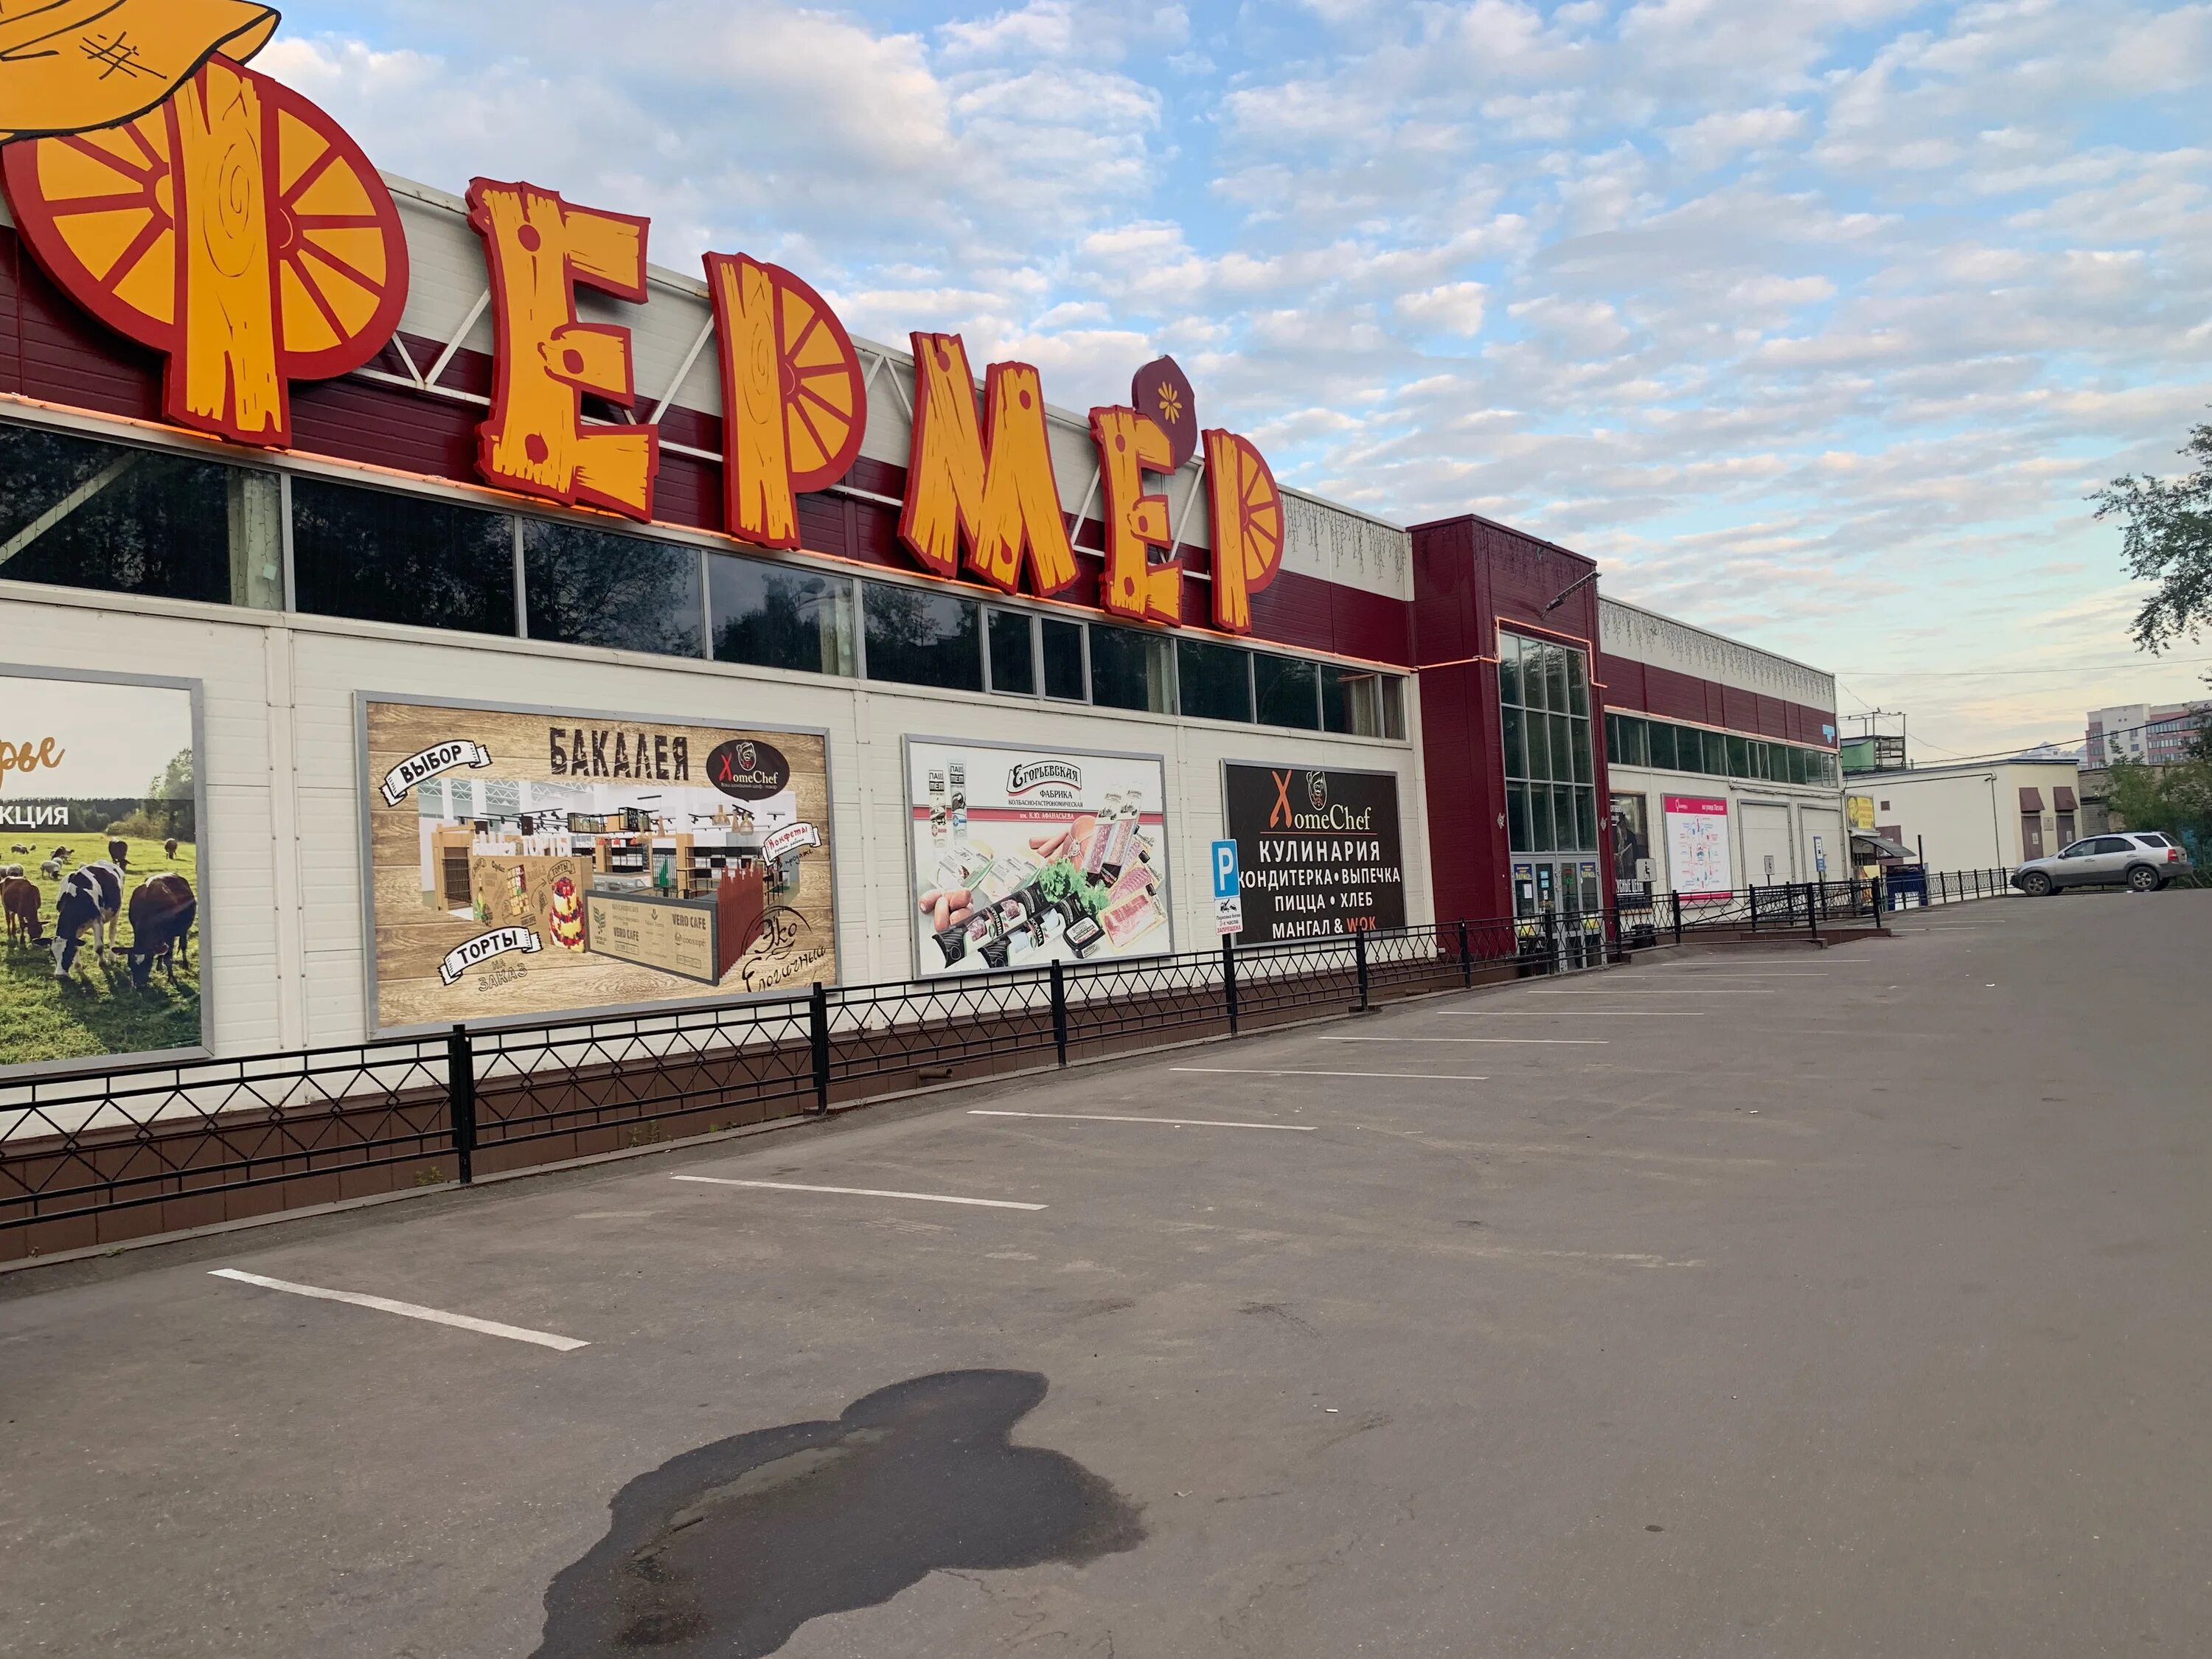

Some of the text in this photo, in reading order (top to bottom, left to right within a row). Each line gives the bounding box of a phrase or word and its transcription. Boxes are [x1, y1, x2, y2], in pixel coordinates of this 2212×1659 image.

[3, 55, 1284, 634] ФЕРМЕР
[400, 745, 462, 784] ВЫБОР
[549, 727, 689, 781] БАКАЛЕЯ
[1008, 799, 1083, 808] КОЛБАСНО-ГАСТРОНОМИЧЕСКАЯ
[1040, 790, 1073, 799] ФАБРИКА
[1259, 841, 1380, 863] КУЛИНАРИЯ
[1343, 867, 1401, 884] ВЫПЕЧКА
[1275, 892, 1373, 913] ПИЦЦА ХЛЕБ
[672, 914, 689, 927] VERO
[689, 917, 706, 931] CAFE
[1272, 919, 1330, 939] МАНГАЛ
[457, 930, 518, 964] ТОРТЫ
[491, 958, 506, 970] НА
[478, 962, 529, 992] ЗАКАЗ
